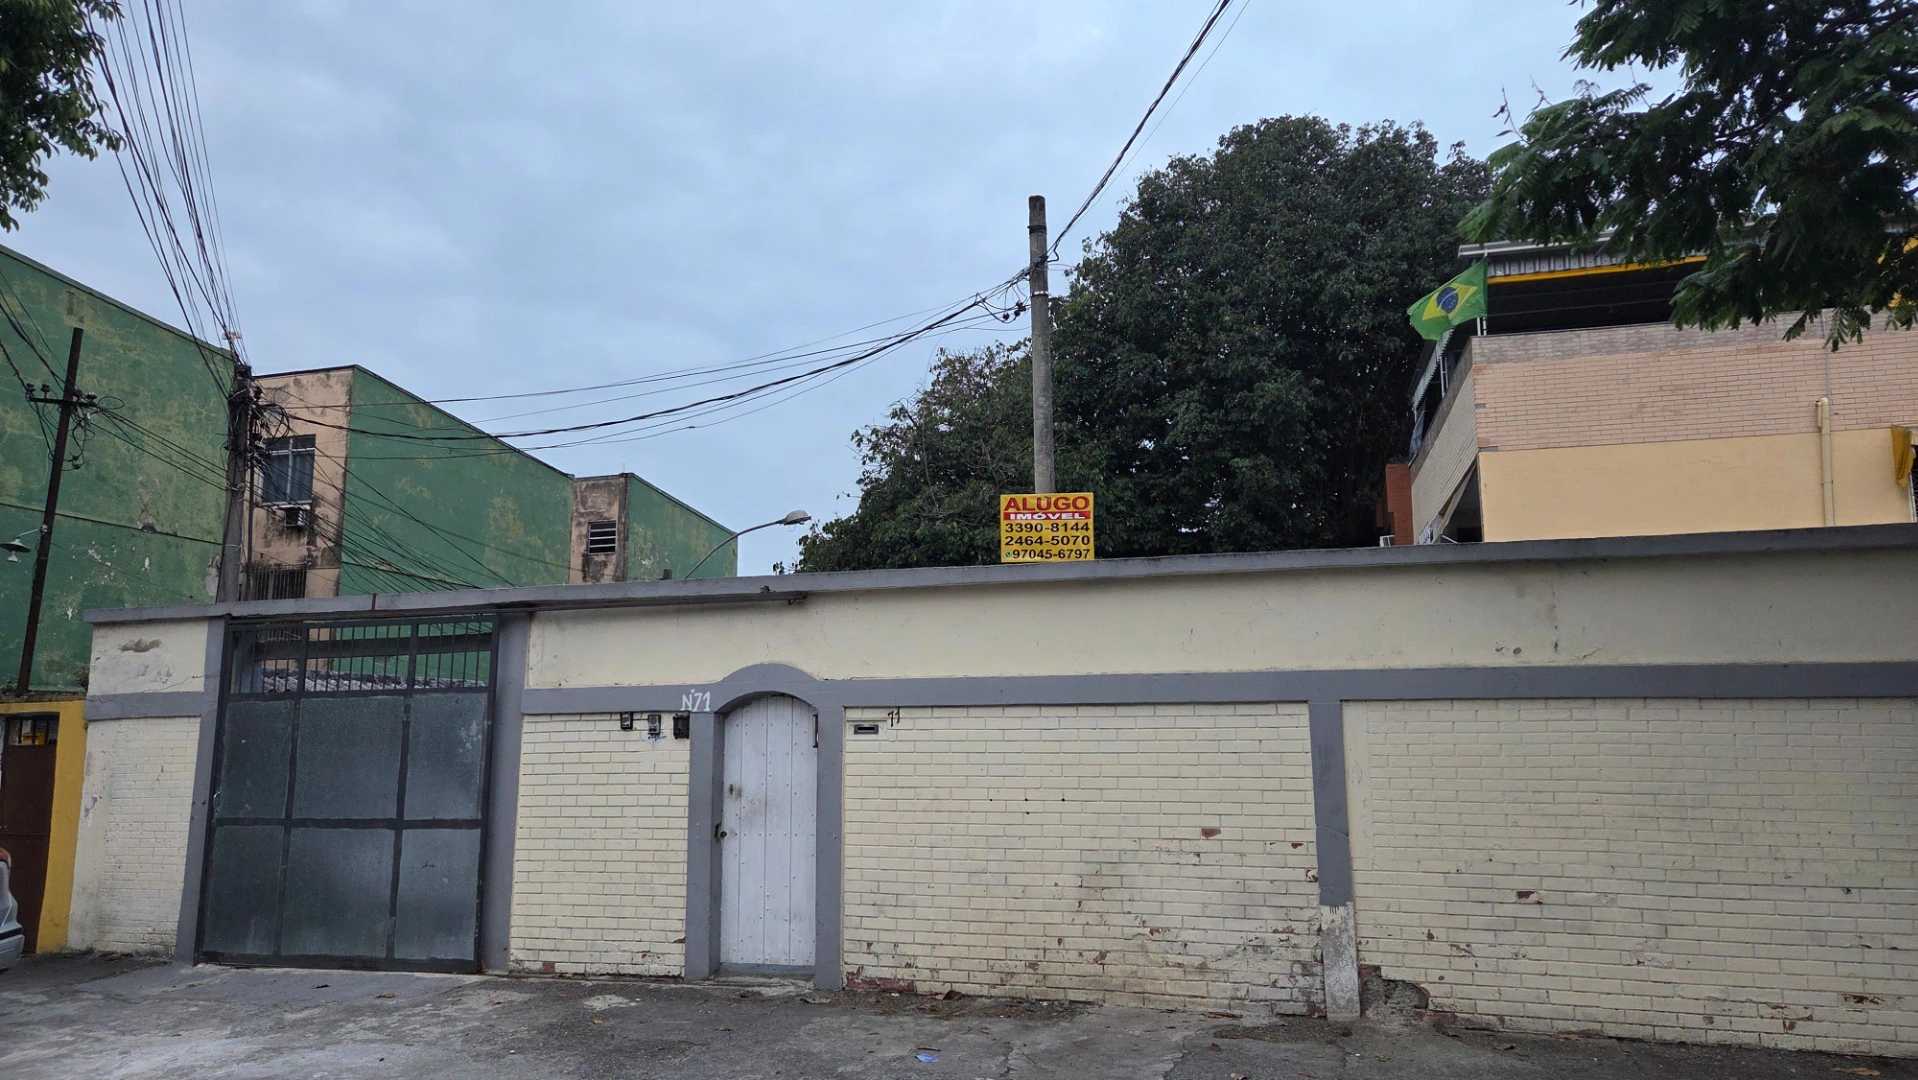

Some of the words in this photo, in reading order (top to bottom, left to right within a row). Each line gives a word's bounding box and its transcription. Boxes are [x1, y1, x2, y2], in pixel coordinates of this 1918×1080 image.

[1004, 496, 1090, 511] ALUGO
[1009, 512, 1086, 520] IMÓVEL
[1005, 522, 1090, 533] 3390-8144
[1004, 535, 1090, 546] 2464-5070
[1012, 549, 1090, 559] 97045-6797
